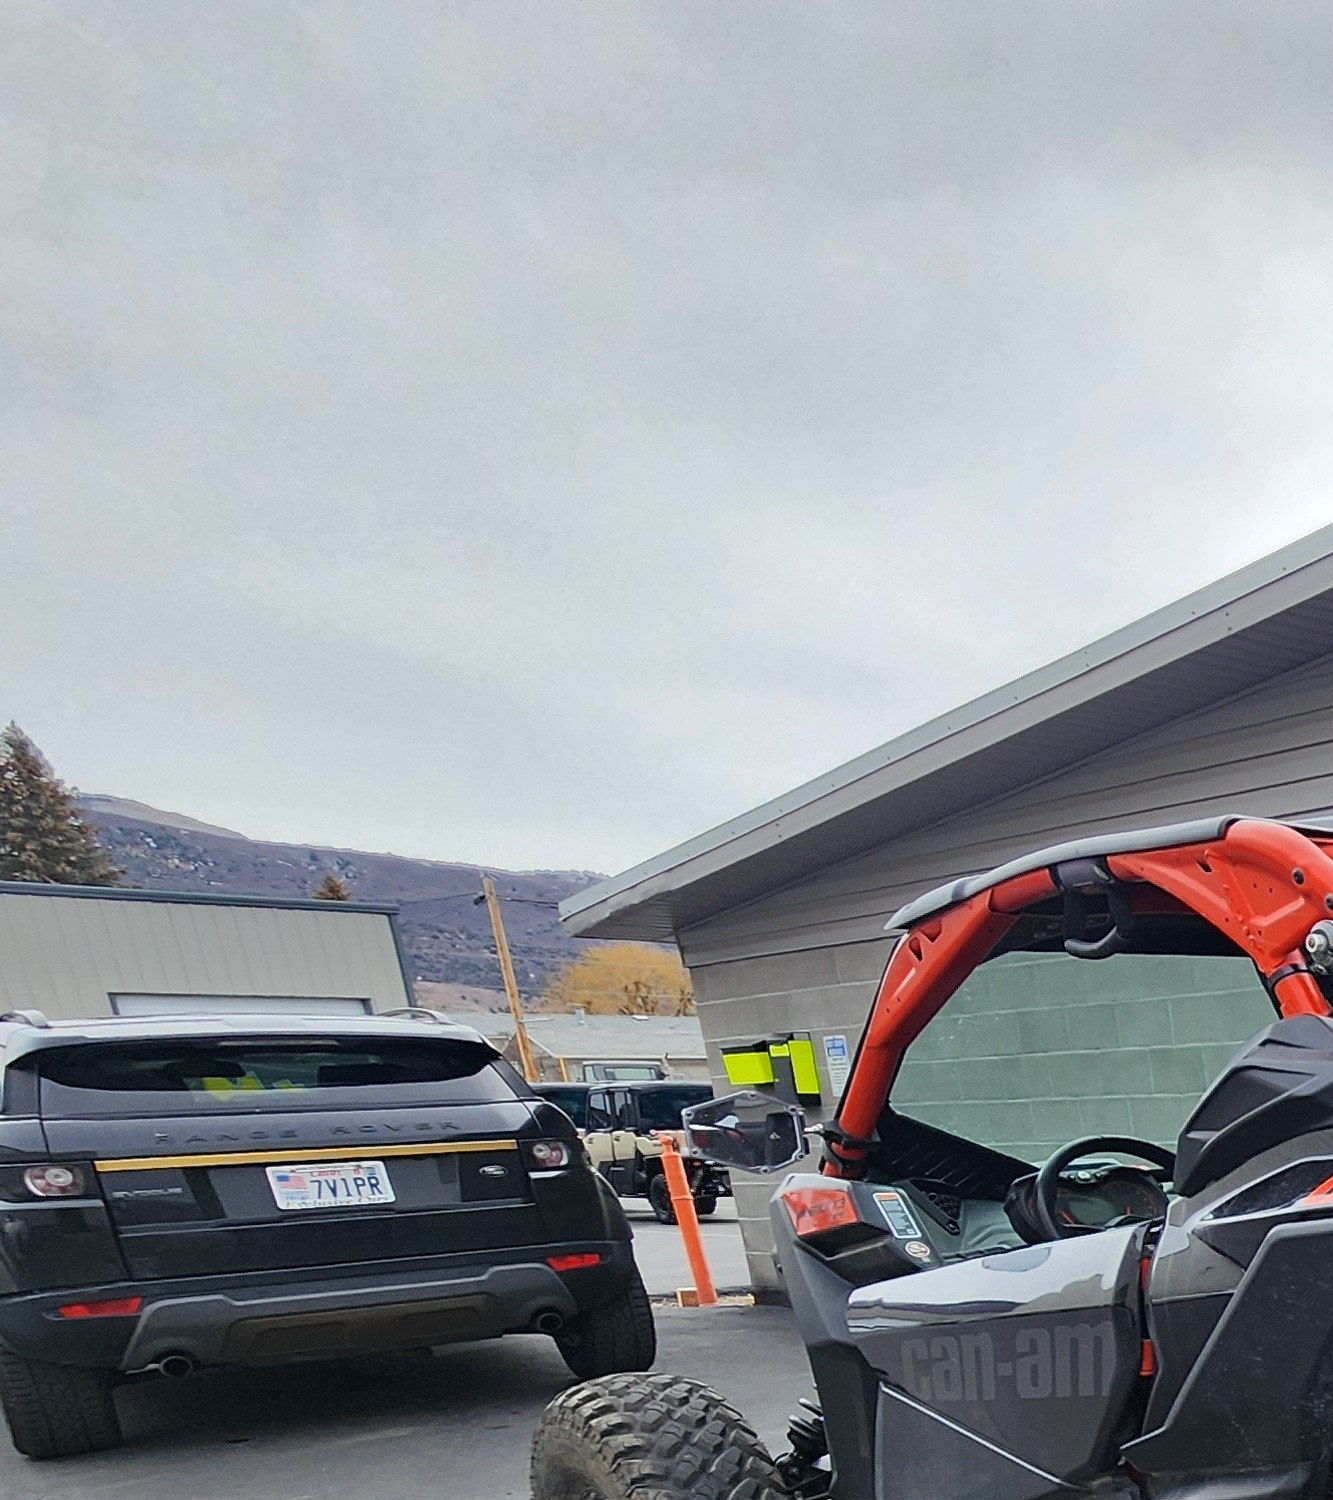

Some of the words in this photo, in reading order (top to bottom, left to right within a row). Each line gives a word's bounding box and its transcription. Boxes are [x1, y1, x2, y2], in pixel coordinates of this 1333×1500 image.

[154, 1129, 299, 1144] RANGE
[331, 1121, 460, 1136] ROVER
[310, 1176, 384, 1199] 7V1PR
[901, 1320, 1117, 1401] can-am
